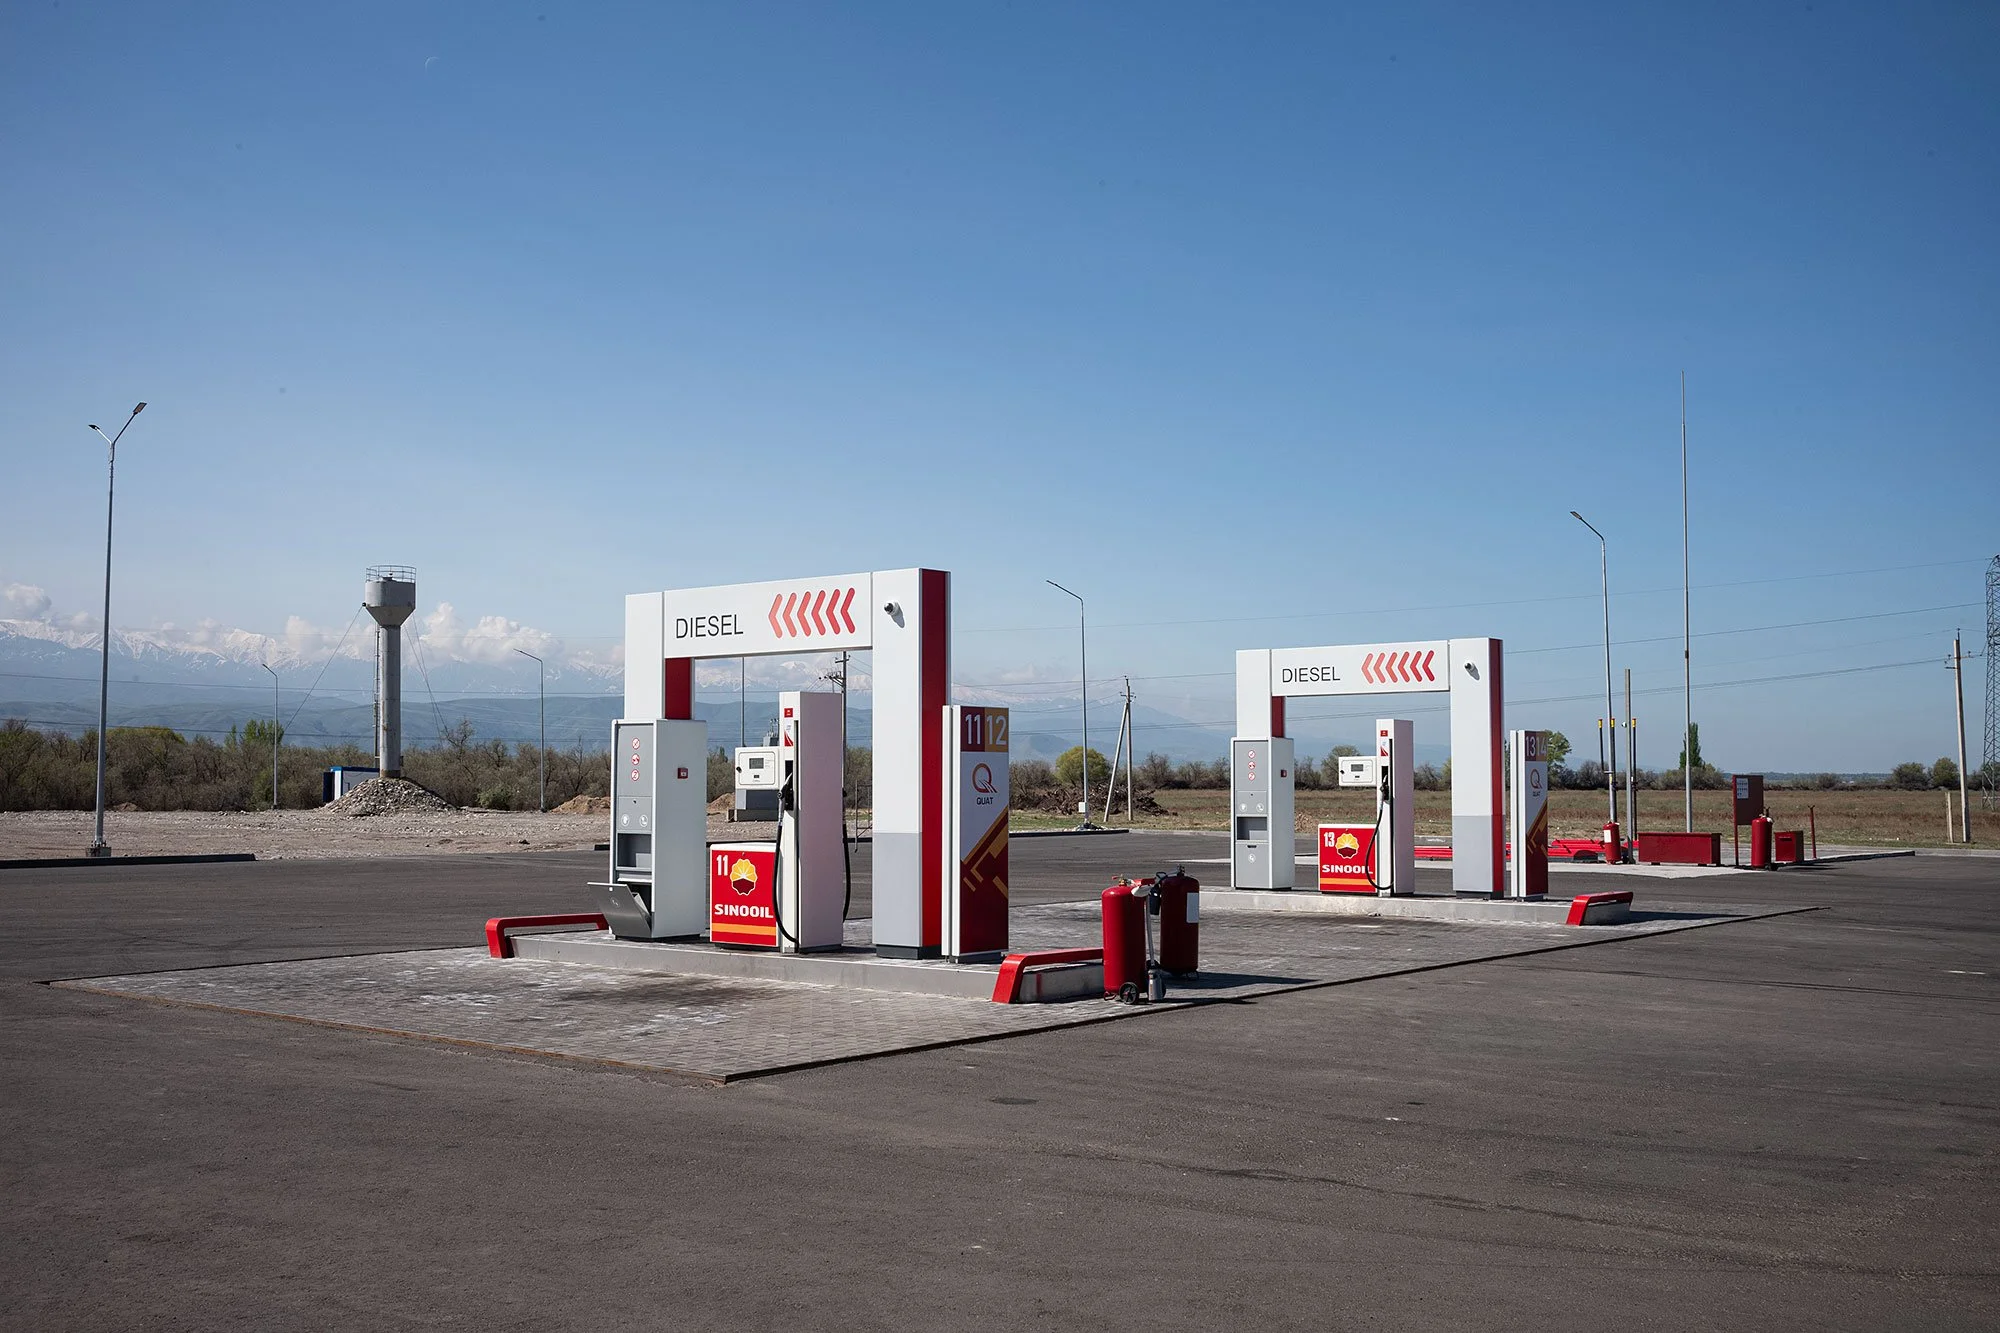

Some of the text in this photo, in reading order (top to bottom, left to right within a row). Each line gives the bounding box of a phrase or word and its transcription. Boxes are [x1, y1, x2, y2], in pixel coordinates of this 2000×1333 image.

[676, 614, 744, 639] DIESEL
[1282, 666, 1341, 683] DIESEL
[965, 714, 981, 745] 11
[986, 715, 1007, 746] 12
[1525, 736, 1536, 757] 13
[976, 797, 994, 806] QUAT
[1323, 831, 1336, 848] 13
[716, 854, 729, 877] 11
[714, 903, 774, 919] SINOOIL
